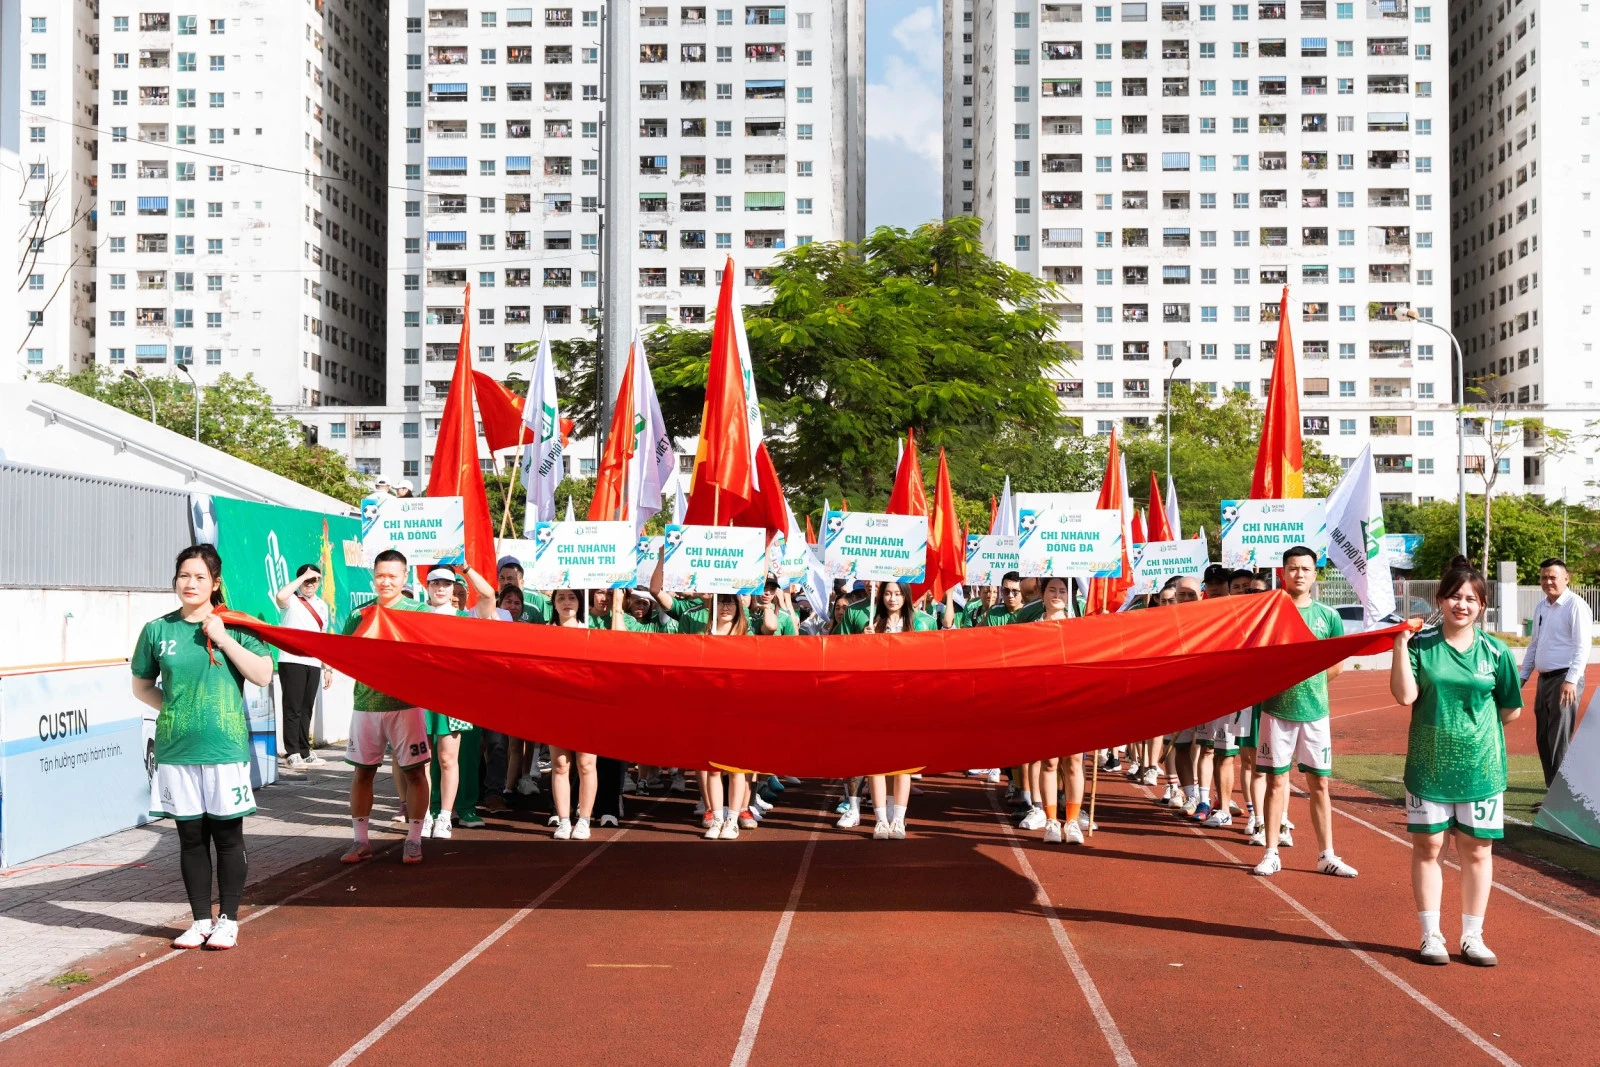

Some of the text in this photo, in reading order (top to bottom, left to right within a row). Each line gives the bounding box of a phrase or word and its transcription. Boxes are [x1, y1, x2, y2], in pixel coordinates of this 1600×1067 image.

[383, 520, 402, 529] CHI
[1242, 523, 1261, 532] CHI
[844, 535, 862, 544] CHI
[1040, 531, 1058, 540] CHI
[1283, 534, 1305, 543] MAI
[1330, 527, 1347, 544] NHÀ
[557, 544, 575, 553] CHI
[685, 546, 702, 556] CHI
[841, 546, 877, 557] THANH
[1079, 543, 1094, 552] ĐA
[558, 556, 595, 565] THANH
[982, 552, 995, 560] CHI
[1146, 559, 1160, 567] CHI
[1141, 568, 1162, 576] NAM
[158, 640, 177, 657] 32
[39, 708, 88, 742] CUSTIN
[409, 741, 428, 757] 38
[40, 757, 54, 774] Tận
[76, 748, 90, 766] mọi
[231, 785, 250, 806] 32
[1474, 798, 1498, 822] 57
